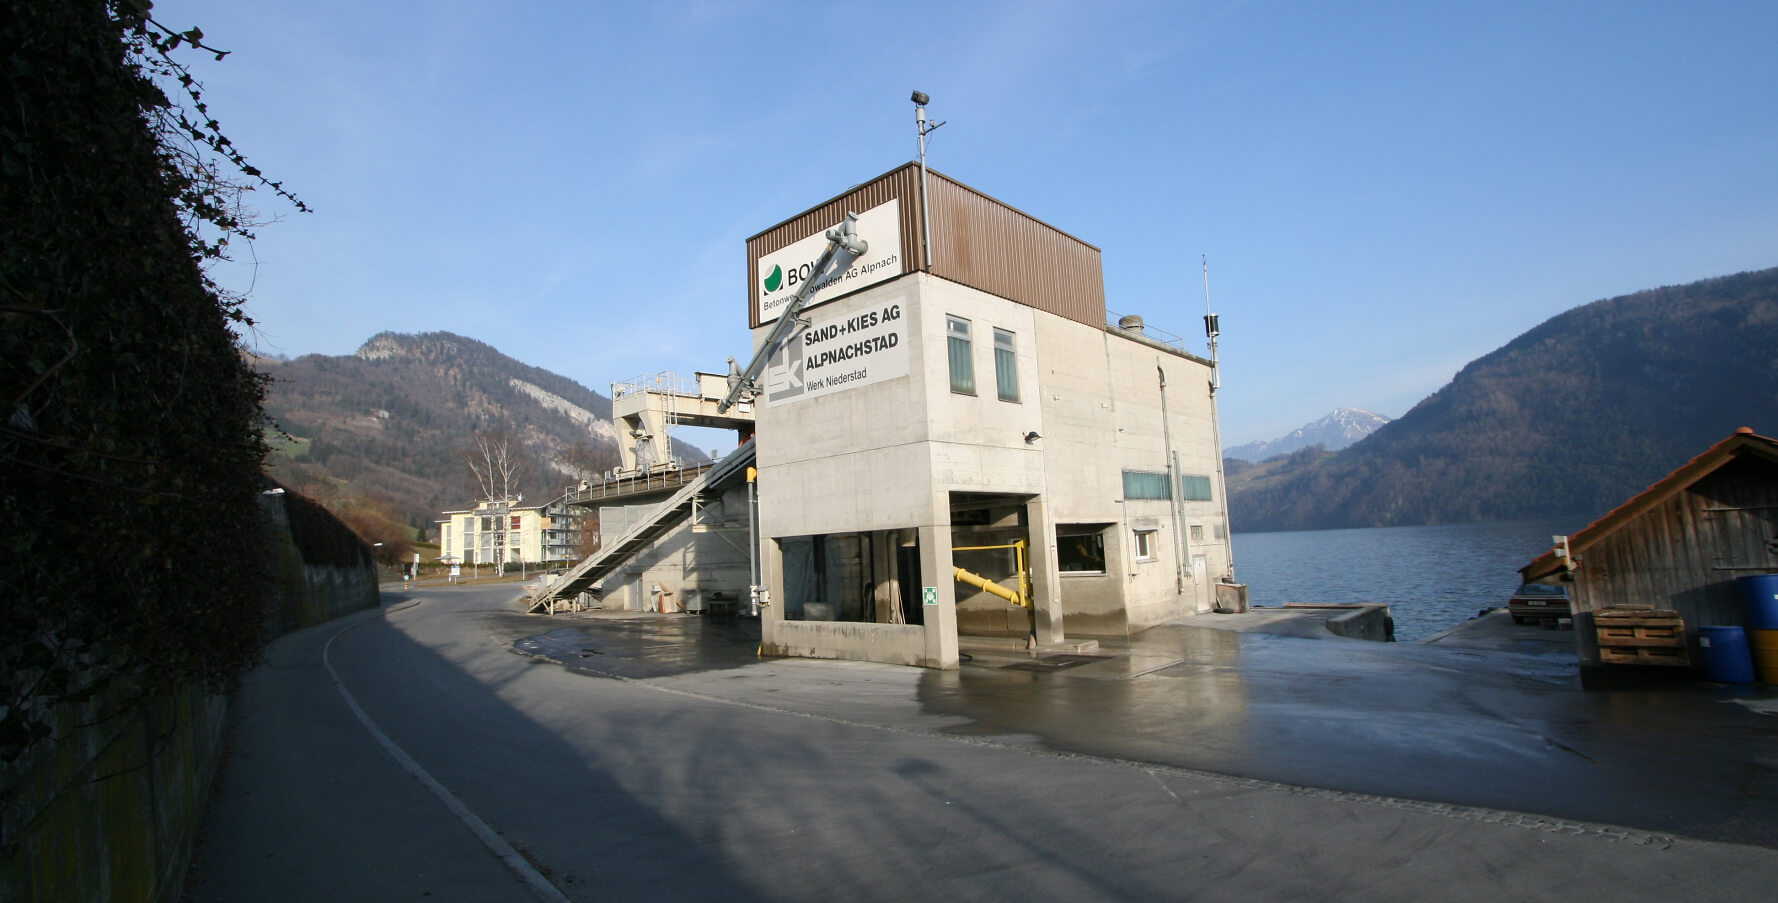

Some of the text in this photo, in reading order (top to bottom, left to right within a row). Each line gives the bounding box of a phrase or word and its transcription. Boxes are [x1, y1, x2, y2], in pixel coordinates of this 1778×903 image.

[845, 268, 859, 280] AG
[860, 254, 897, 275] Alpnach
[881, 304, 901, 324] AG
[806, 332, 899, 371] ALPNACHSTAD
[806, 367, 867, 392] Werk Niederstad
